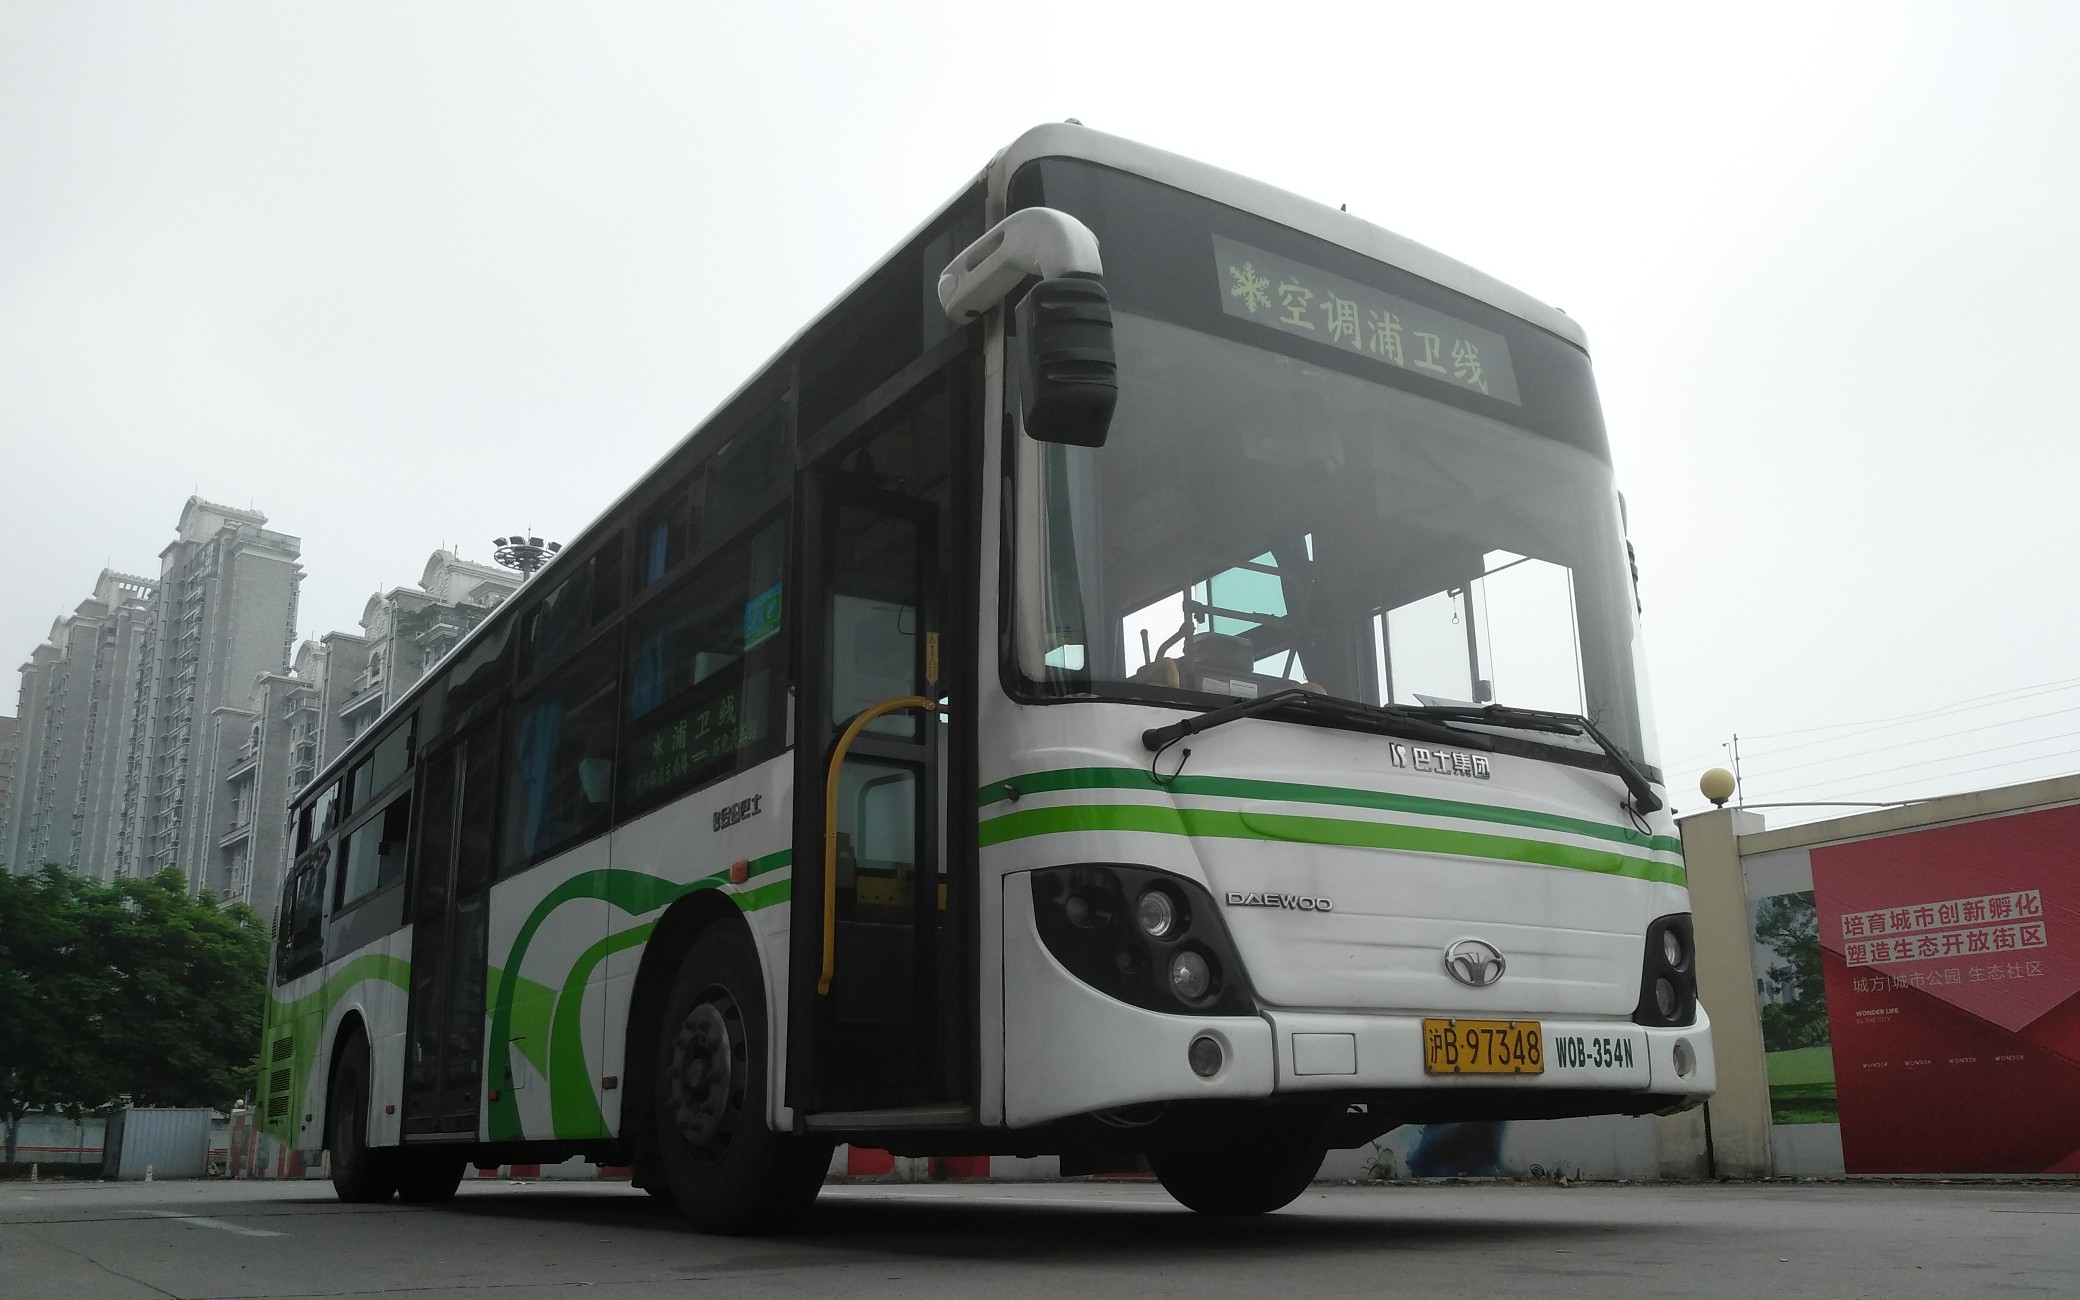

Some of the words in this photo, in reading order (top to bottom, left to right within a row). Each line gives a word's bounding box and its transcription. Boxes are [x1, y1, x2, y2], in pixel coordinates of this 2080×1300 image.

[1278, 275, 1489, 396] 空调浦卫线
[1412, 747, 1490, 780] 巴士集团
[1226, 892, 1333, 912] DAEWOO
[1843, 893, 2040, 937] 培育城市创新孵化
[1846, 924, 2045, 966] 塑造生态开放街区
[1969, 961, 2044, 983] 生态社区
